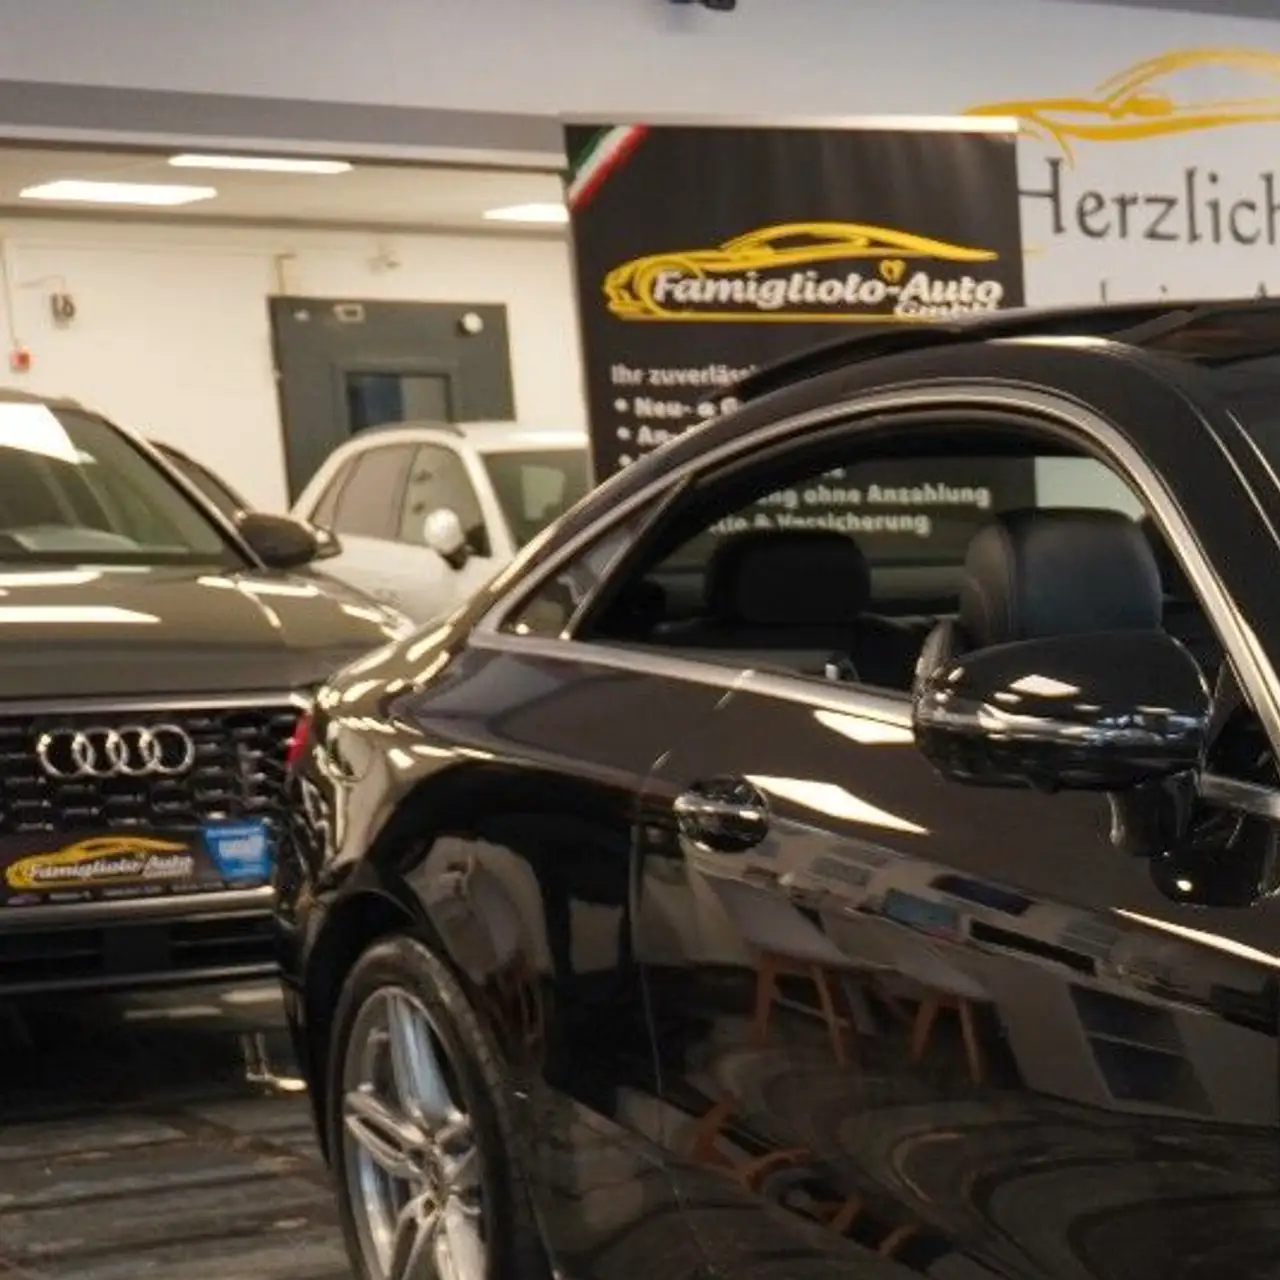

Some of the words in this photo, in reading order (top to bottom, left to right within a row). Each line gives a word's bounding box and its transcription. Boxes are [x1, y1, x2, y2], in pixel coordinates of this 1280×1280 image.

[653, 270, 1003, 310] Famigliolo-Auto
[804, 484, 861, 504] ohne
[866, 483, 990, 508] Anzahlung
